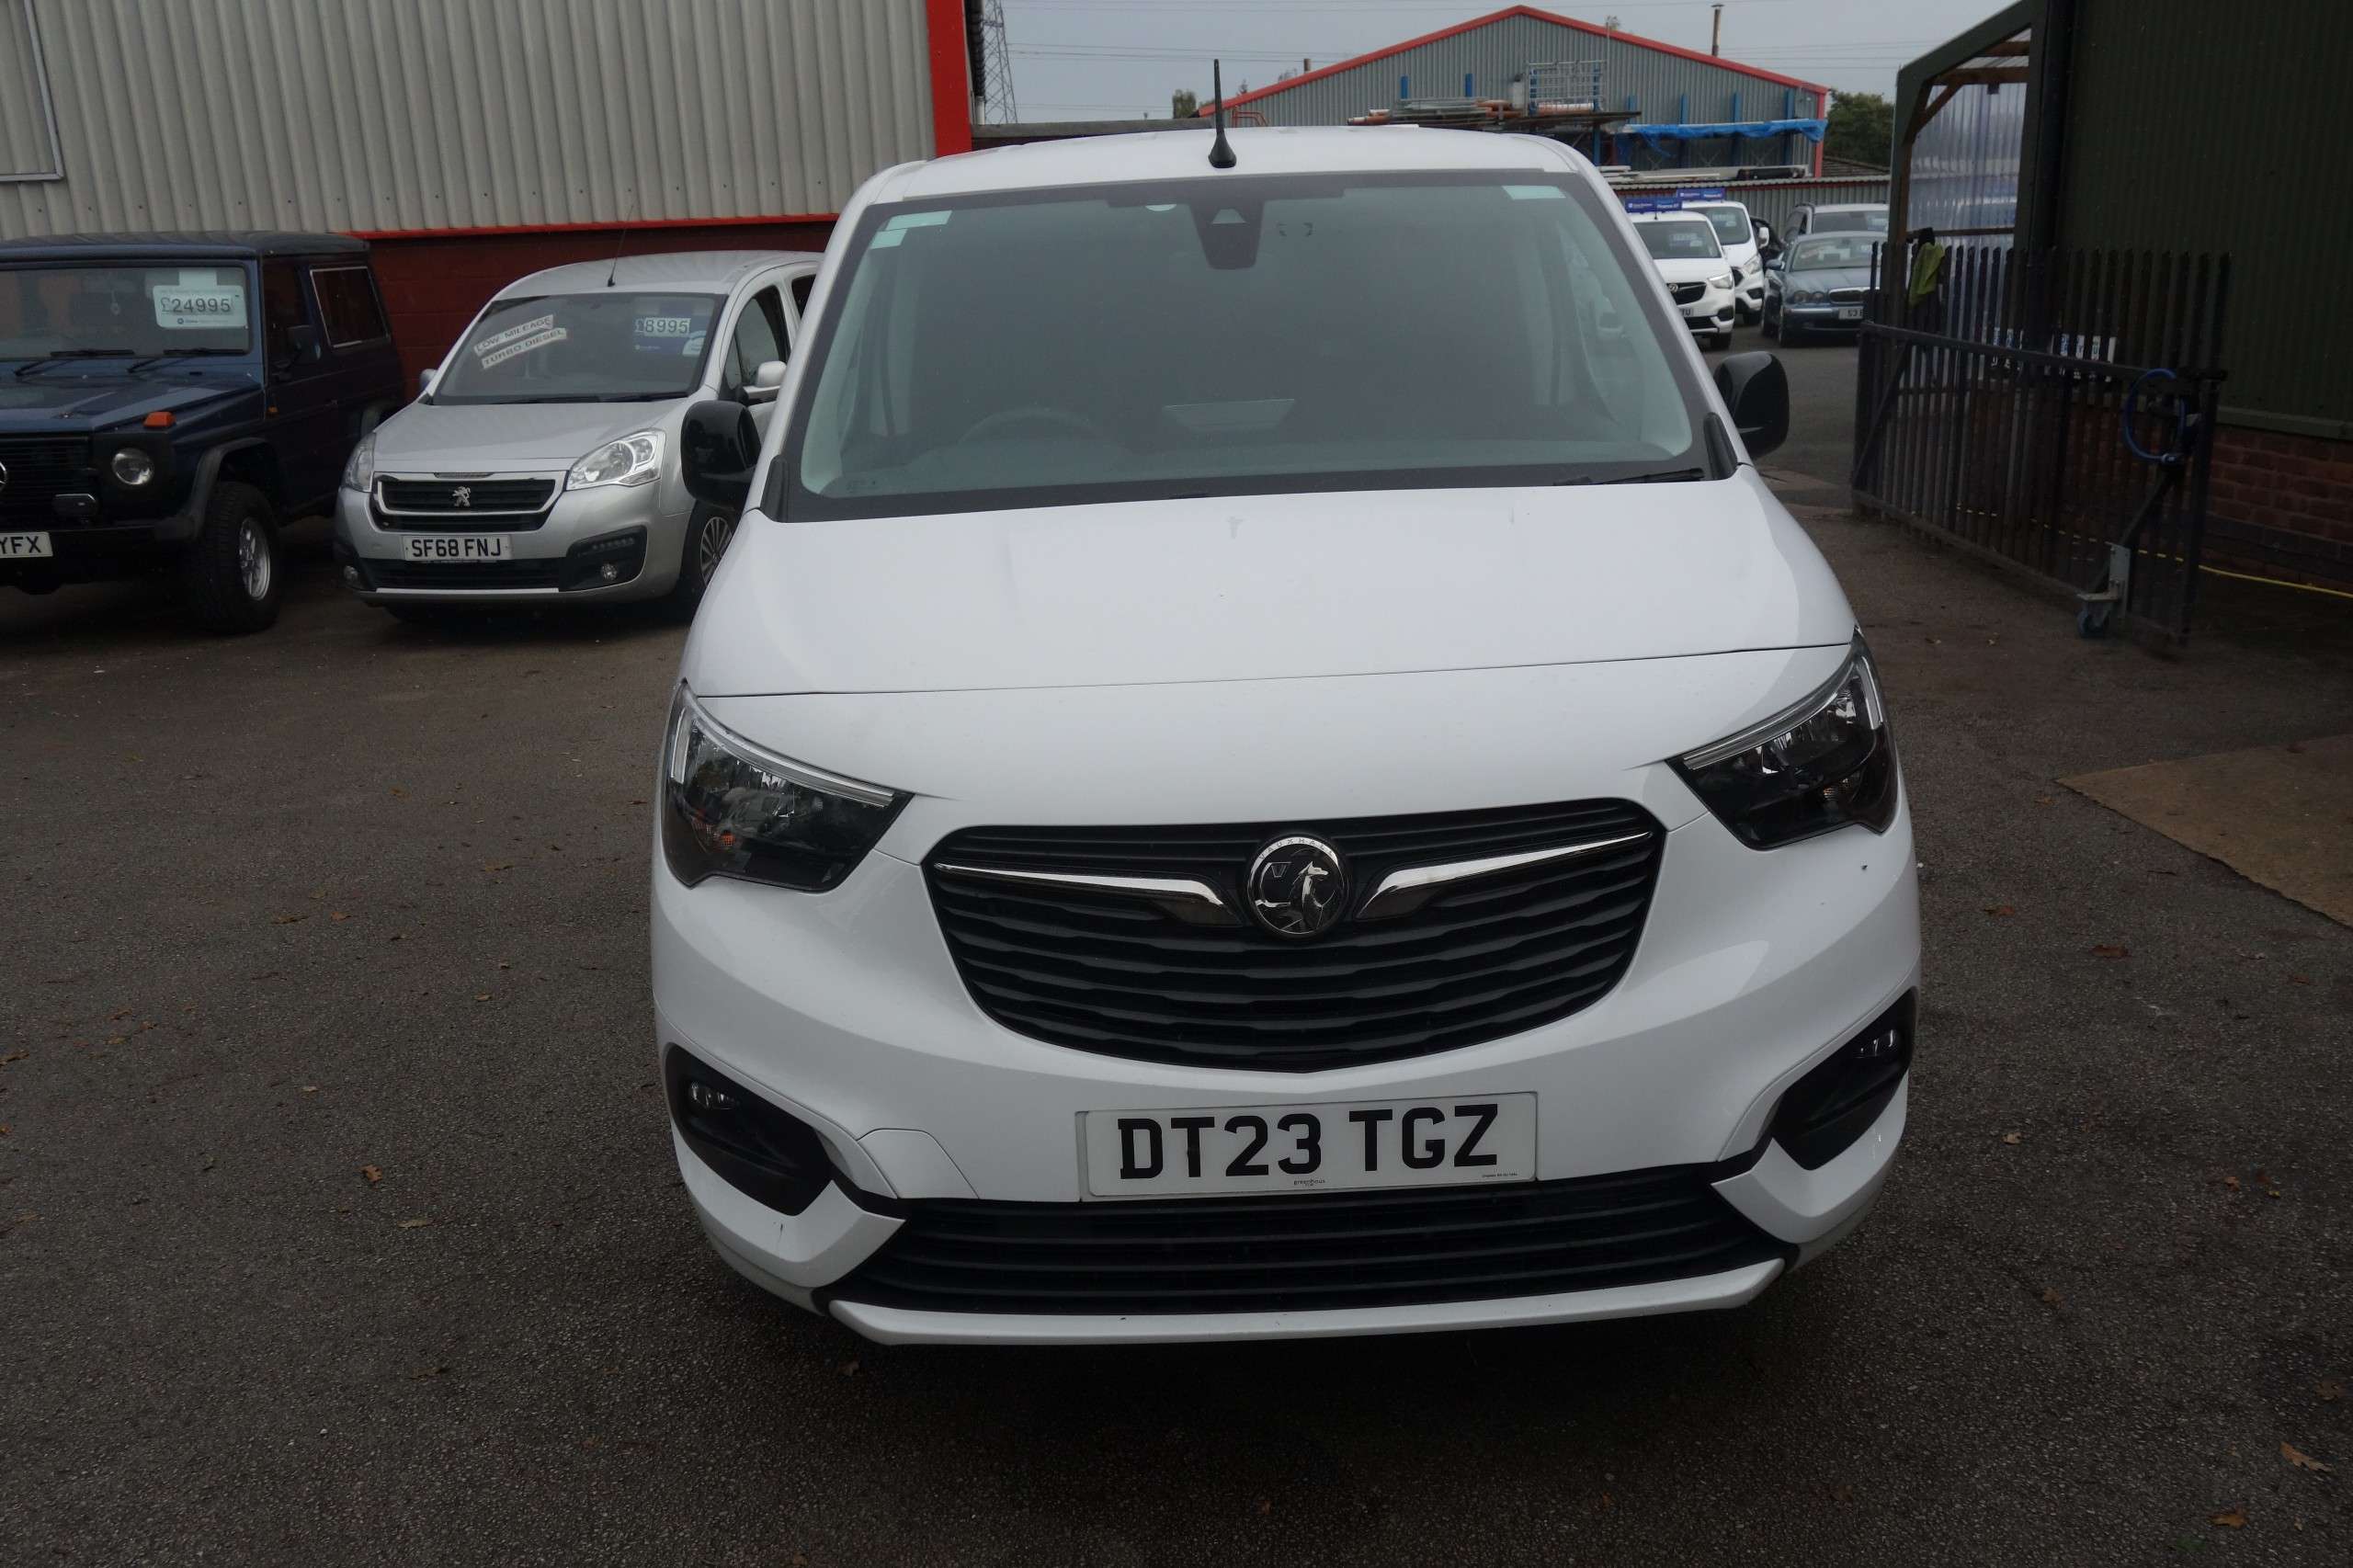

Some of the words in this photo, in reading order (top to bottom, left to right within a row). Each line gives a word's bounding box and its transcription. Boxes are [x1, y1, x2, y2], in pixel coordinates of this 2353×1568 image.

[161, 296, 231, 314] £24995
[476, 335, 500, 351] LOW
[504, 317, 552, 339] MILEAGE
[483, 344, 522, 366] TURBO
[525, 328, 565, 348] DIESEL
[411, 539, 460, 557] SF68
[464, 538, 502, 557] FNJ
[1258, 837, 1335, 860] VAUXHALL
[1118, 1113, 1322, 1179] DT23
[1348, 1103, 1498, 1173] TGZ
